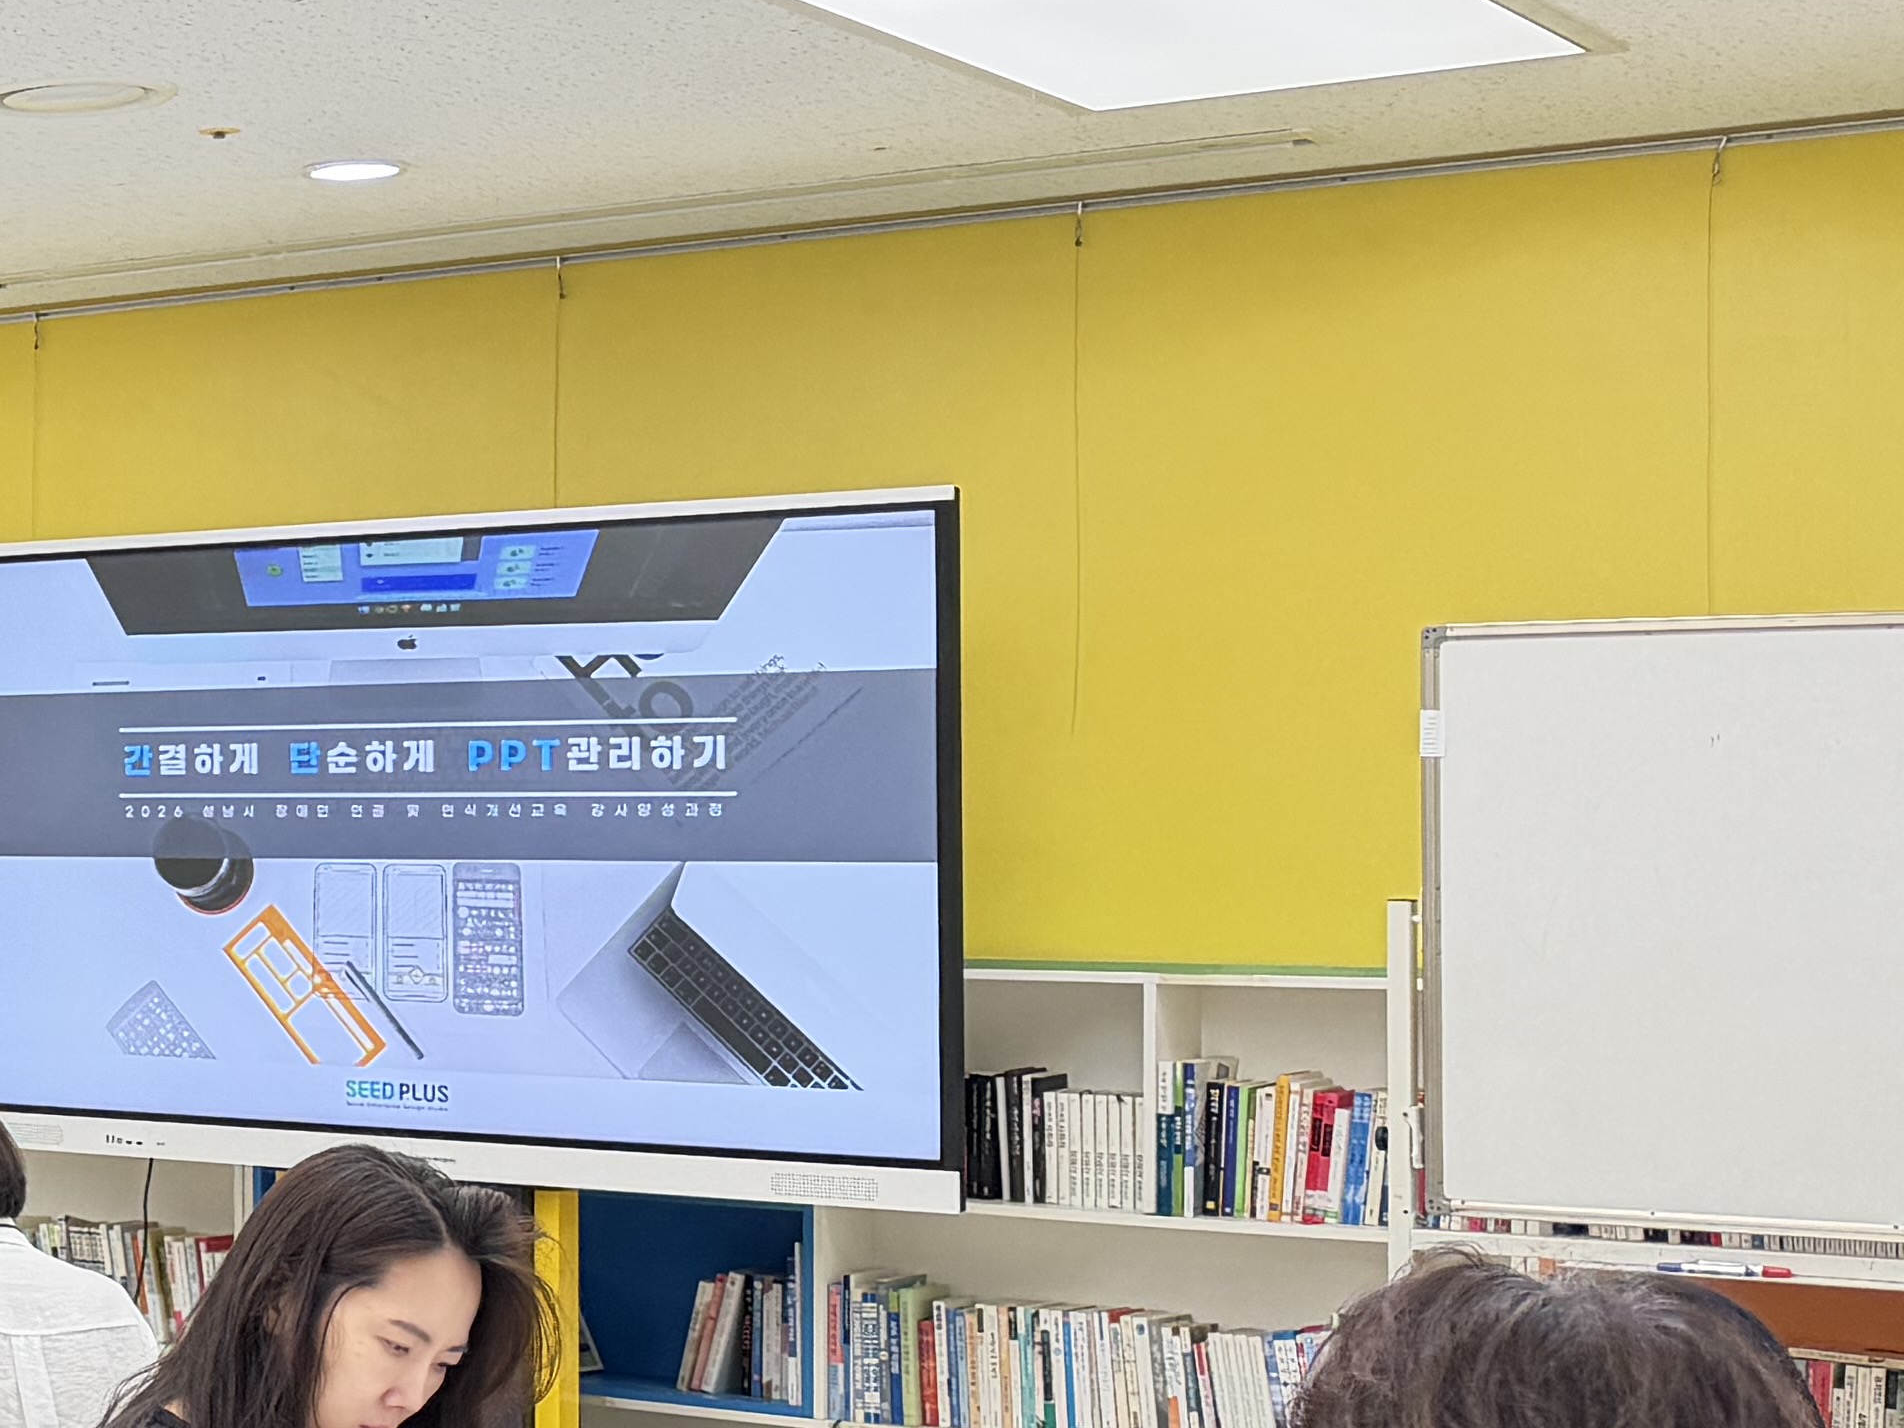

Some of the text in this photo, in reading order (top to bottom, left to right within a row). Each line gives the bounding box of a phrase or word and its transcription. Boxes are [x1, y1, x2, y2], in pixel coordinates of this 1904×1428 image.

[124, 735, 726, 776] 간결하게 단순하게 PPT관리하기
[125, 805, 184, 818] 2026
[346, 1079, 449, 1103] SEED PLUS
